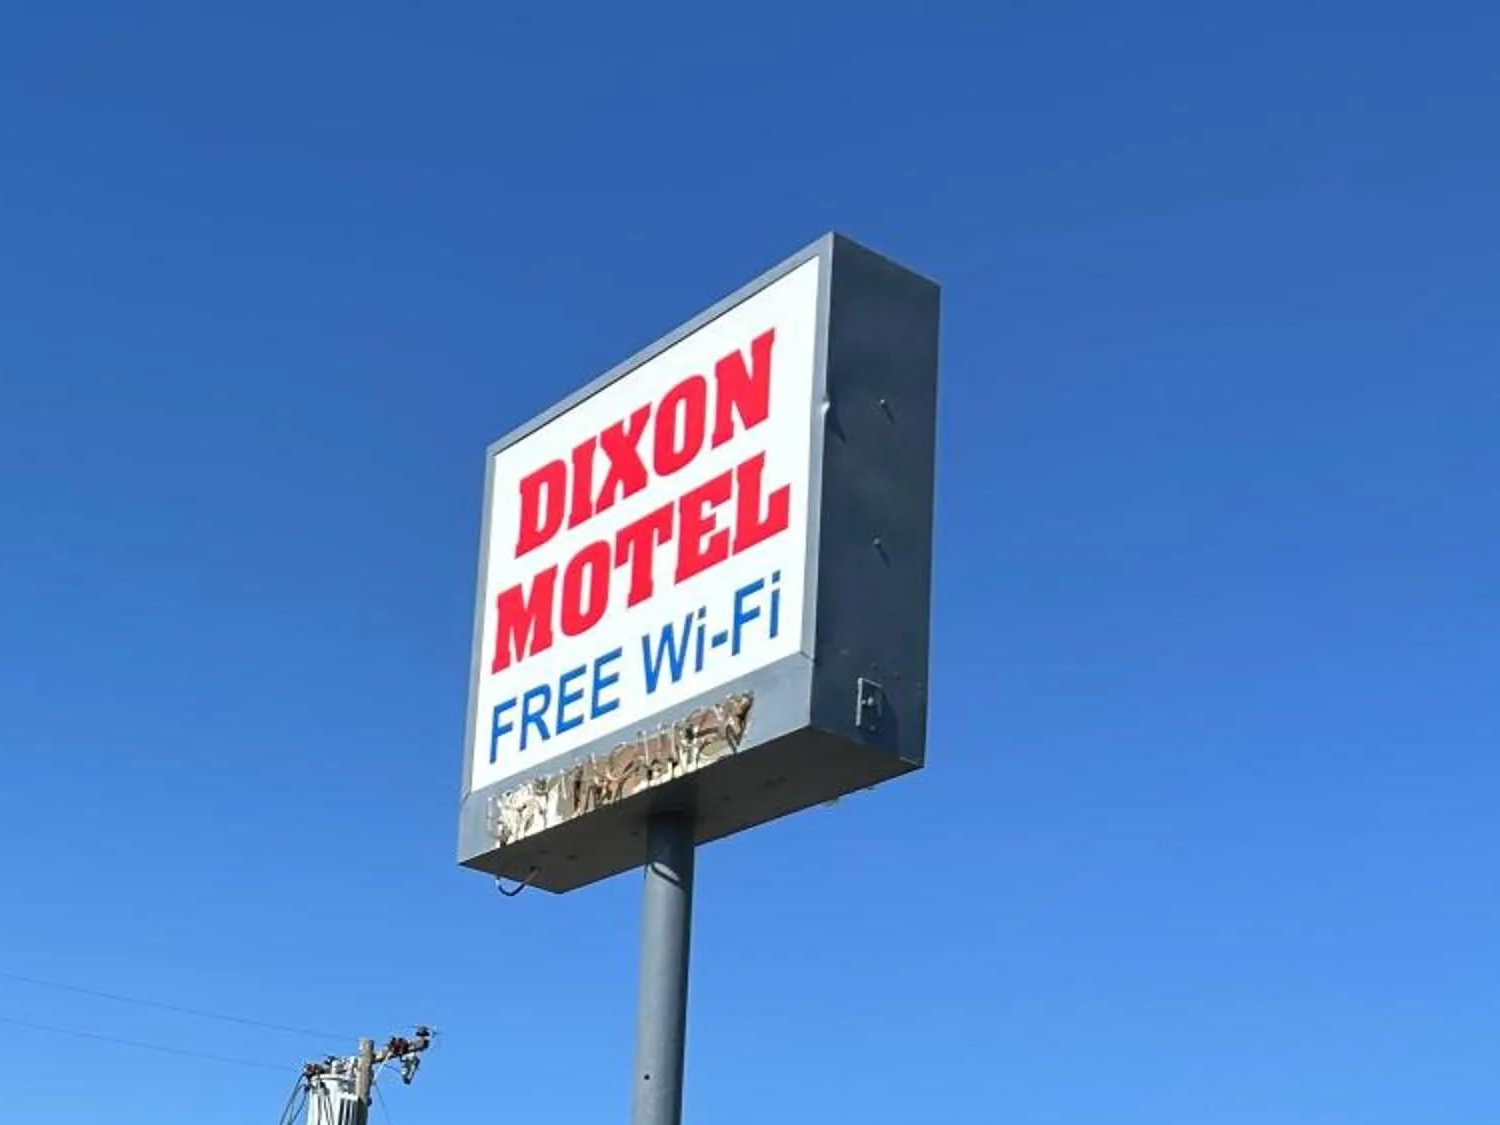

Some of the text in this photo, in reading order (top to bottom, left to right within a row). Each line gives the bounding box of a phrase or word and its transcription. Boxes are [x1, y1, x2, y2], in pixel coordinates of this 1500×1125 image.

[515, 326, 776, 558] DIXON
[489, 570, 781, 765] FREE Wi-Fi
[491, 450, 792, 674] MOTEL
